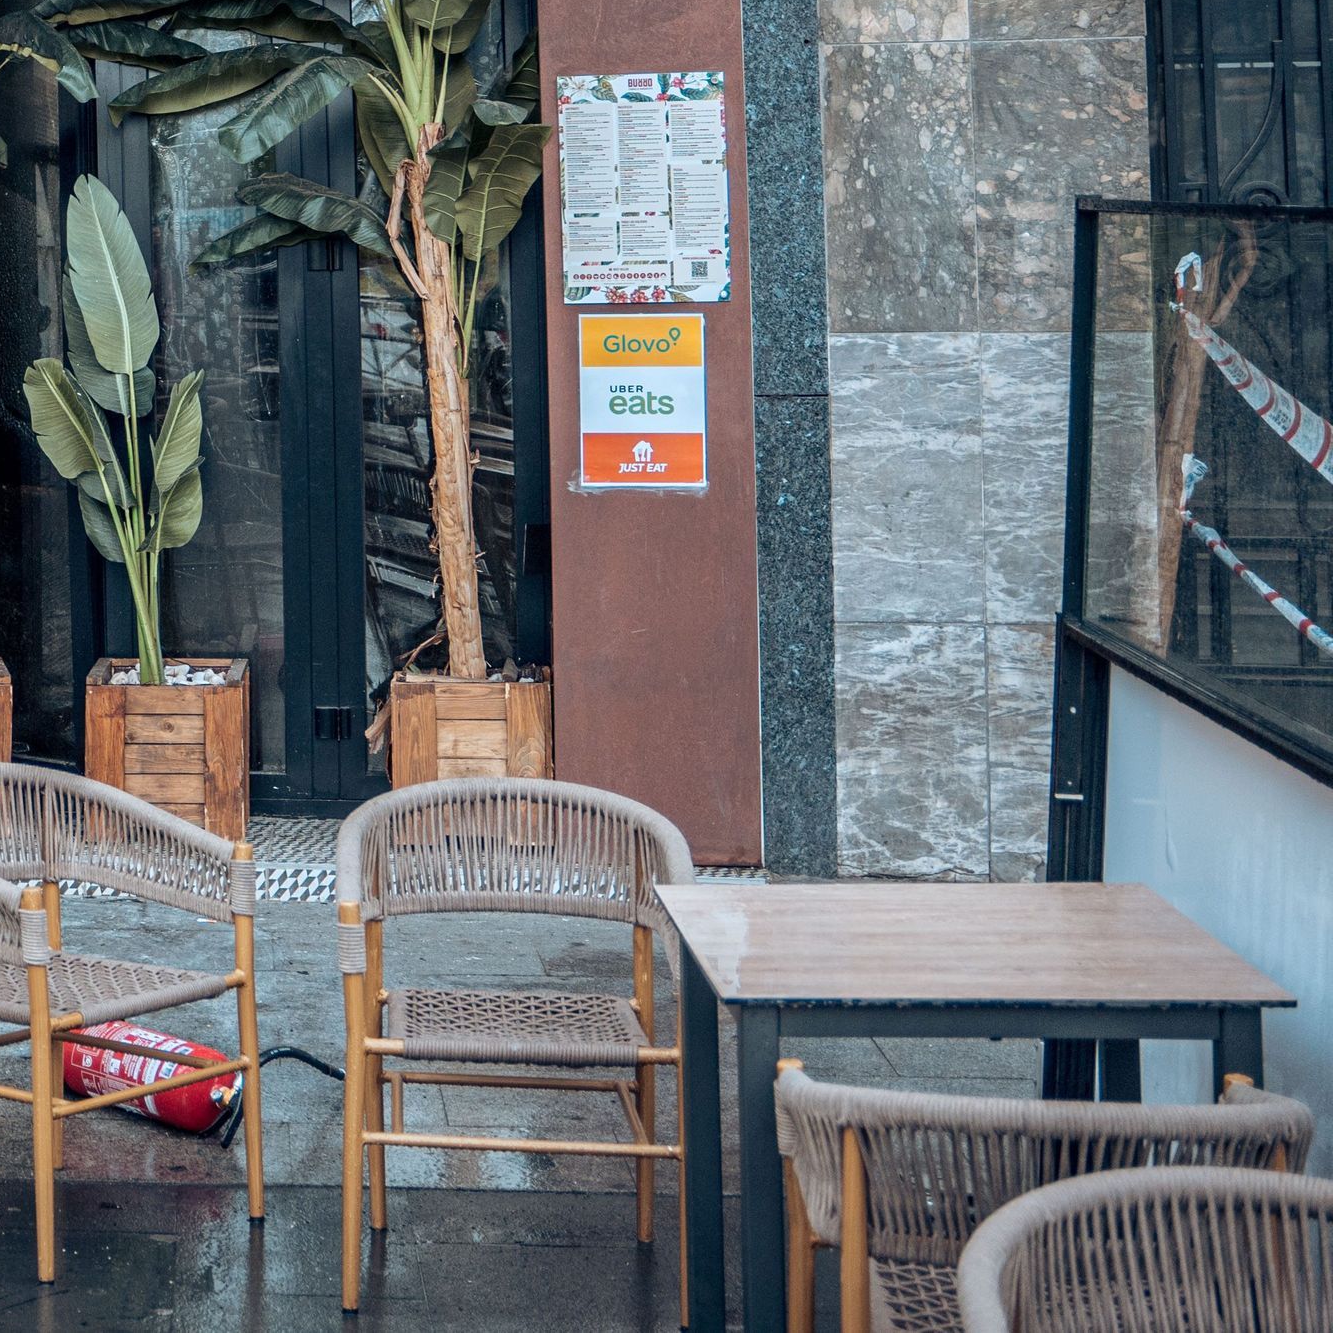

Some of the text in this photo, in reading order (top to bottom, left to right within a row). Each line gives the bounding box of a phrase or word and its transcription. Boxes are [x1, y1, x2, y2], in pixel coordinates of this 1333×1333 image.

[603, 332, 672, 353] Glovo
[609, 385, 644, 393] UBER
[608, 391, 675, 415] eats
[618, 463, 668, 474] JUST EAT
